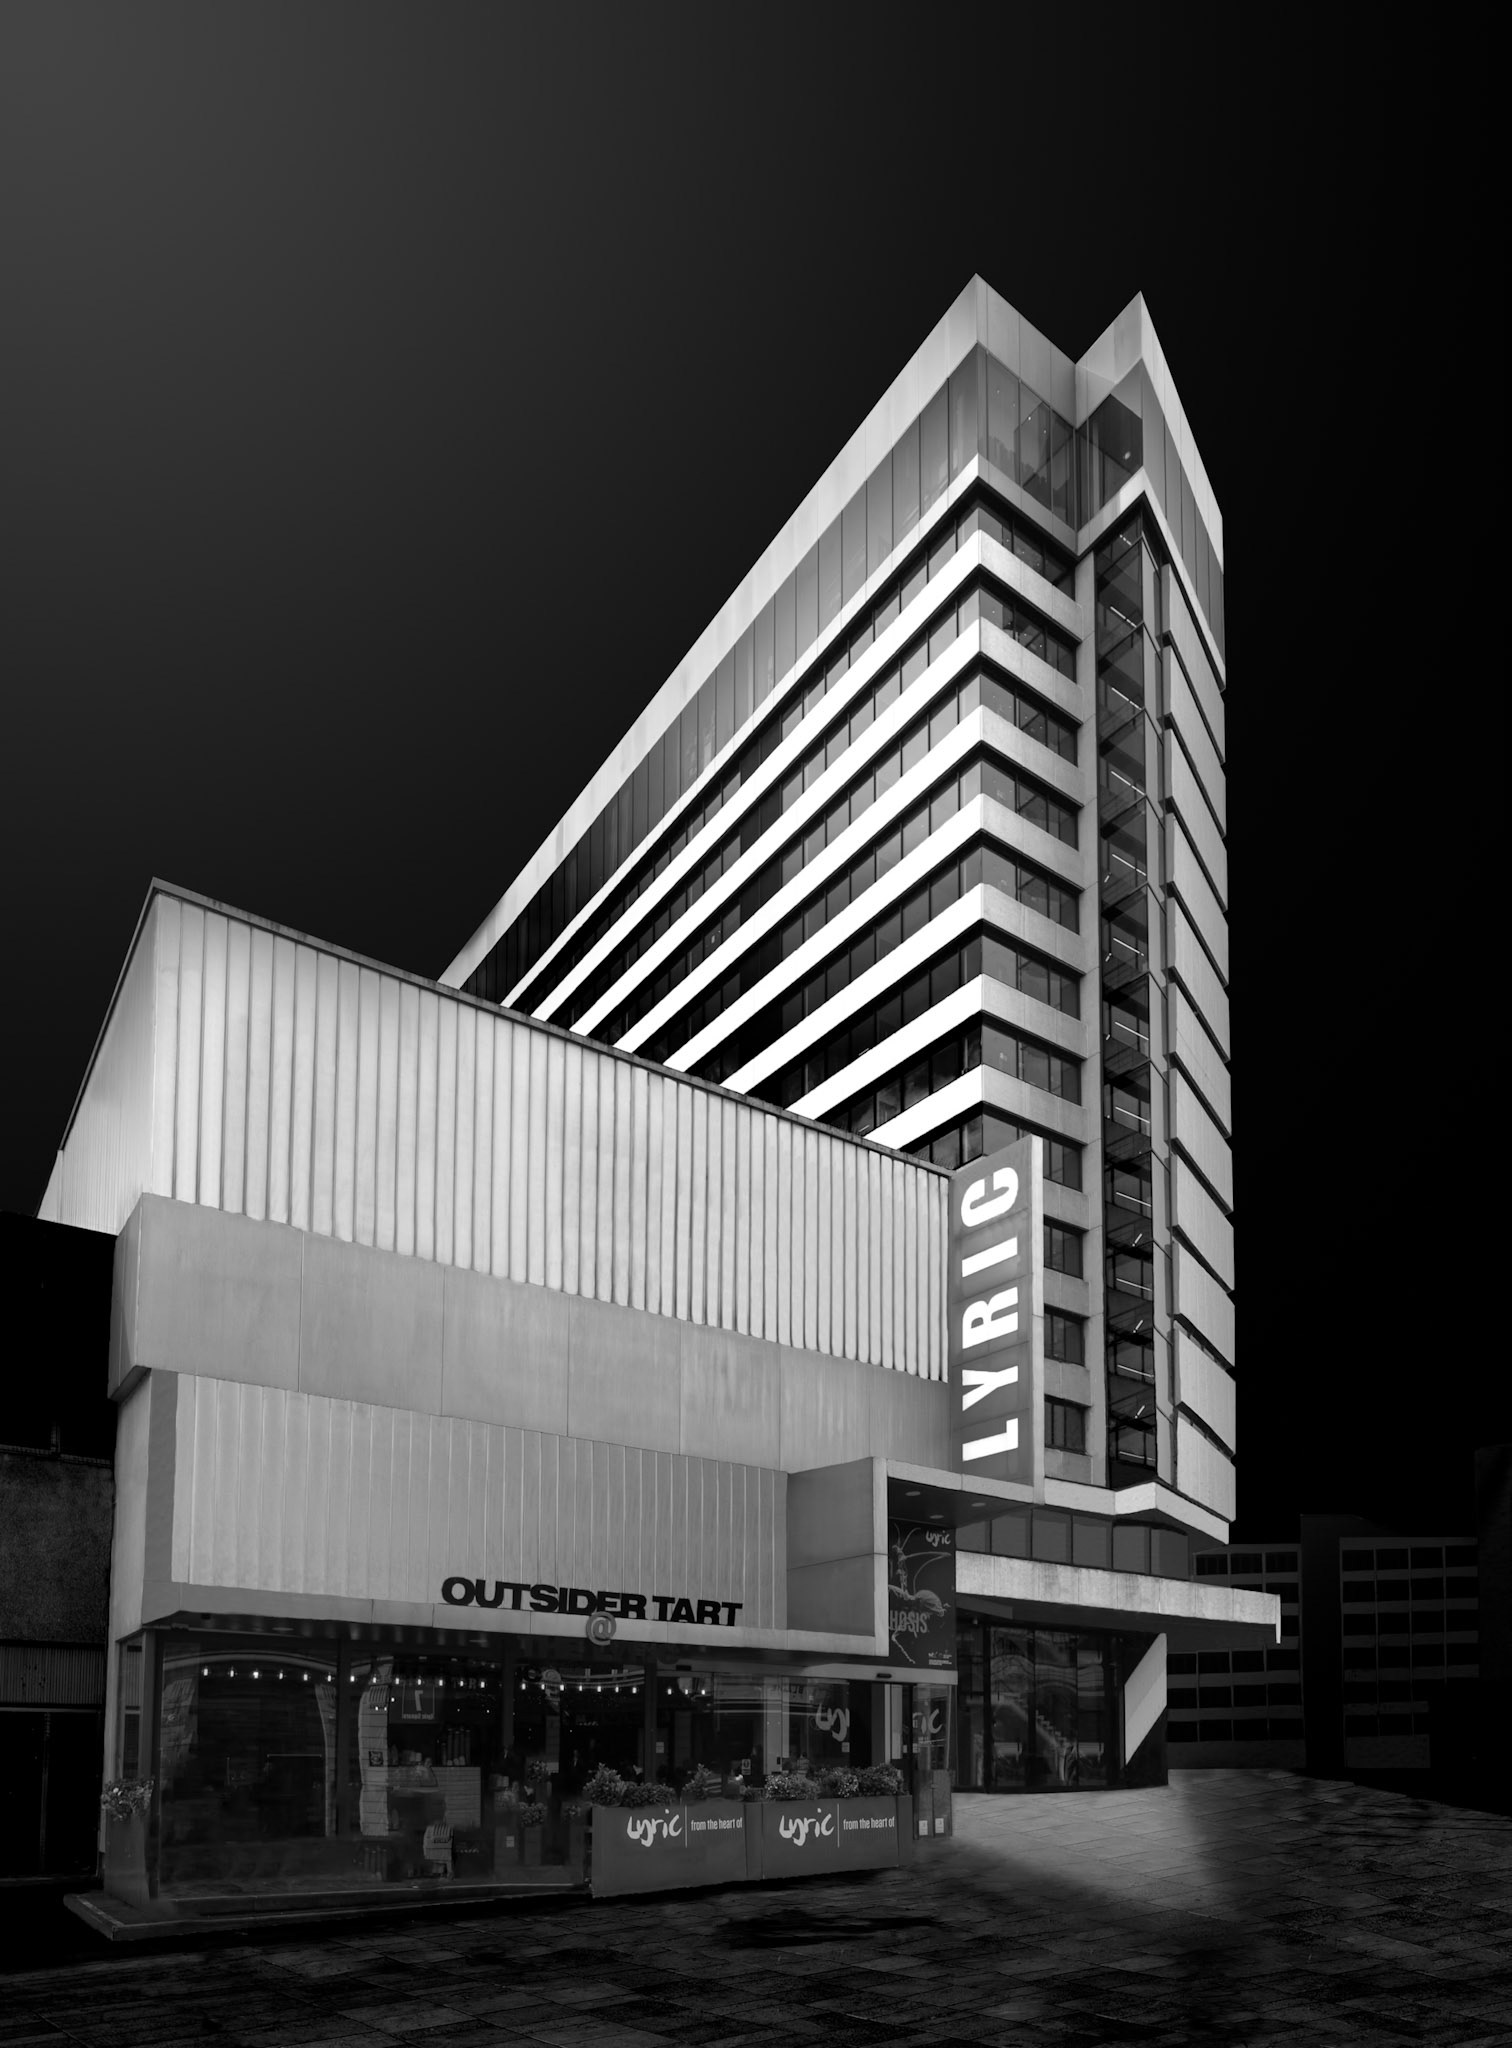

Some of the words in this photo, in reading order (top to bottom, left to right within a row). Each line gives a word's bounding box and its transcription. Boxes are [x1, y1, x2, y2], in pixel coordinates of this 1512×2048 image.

[960, 1166, 1019, 1462] LYRIC
[441, 1576, 647, 1620] OUTSIDER
[652, 1595, 743, 1626] TART
[586, 1611, 616, 1646] @
[690, 1819, 707, 1831] from
[707, 1818, 718, 1830] the
[718, 1818, 736, 1829] heart
[736, 1817, 743, 1829] of
[843, 1818, 859, 1831] from
[859, 1817, 870, 1829] the
[870, 1817, 888, 1829] heart
[888, 1816, 895, 1828] of
